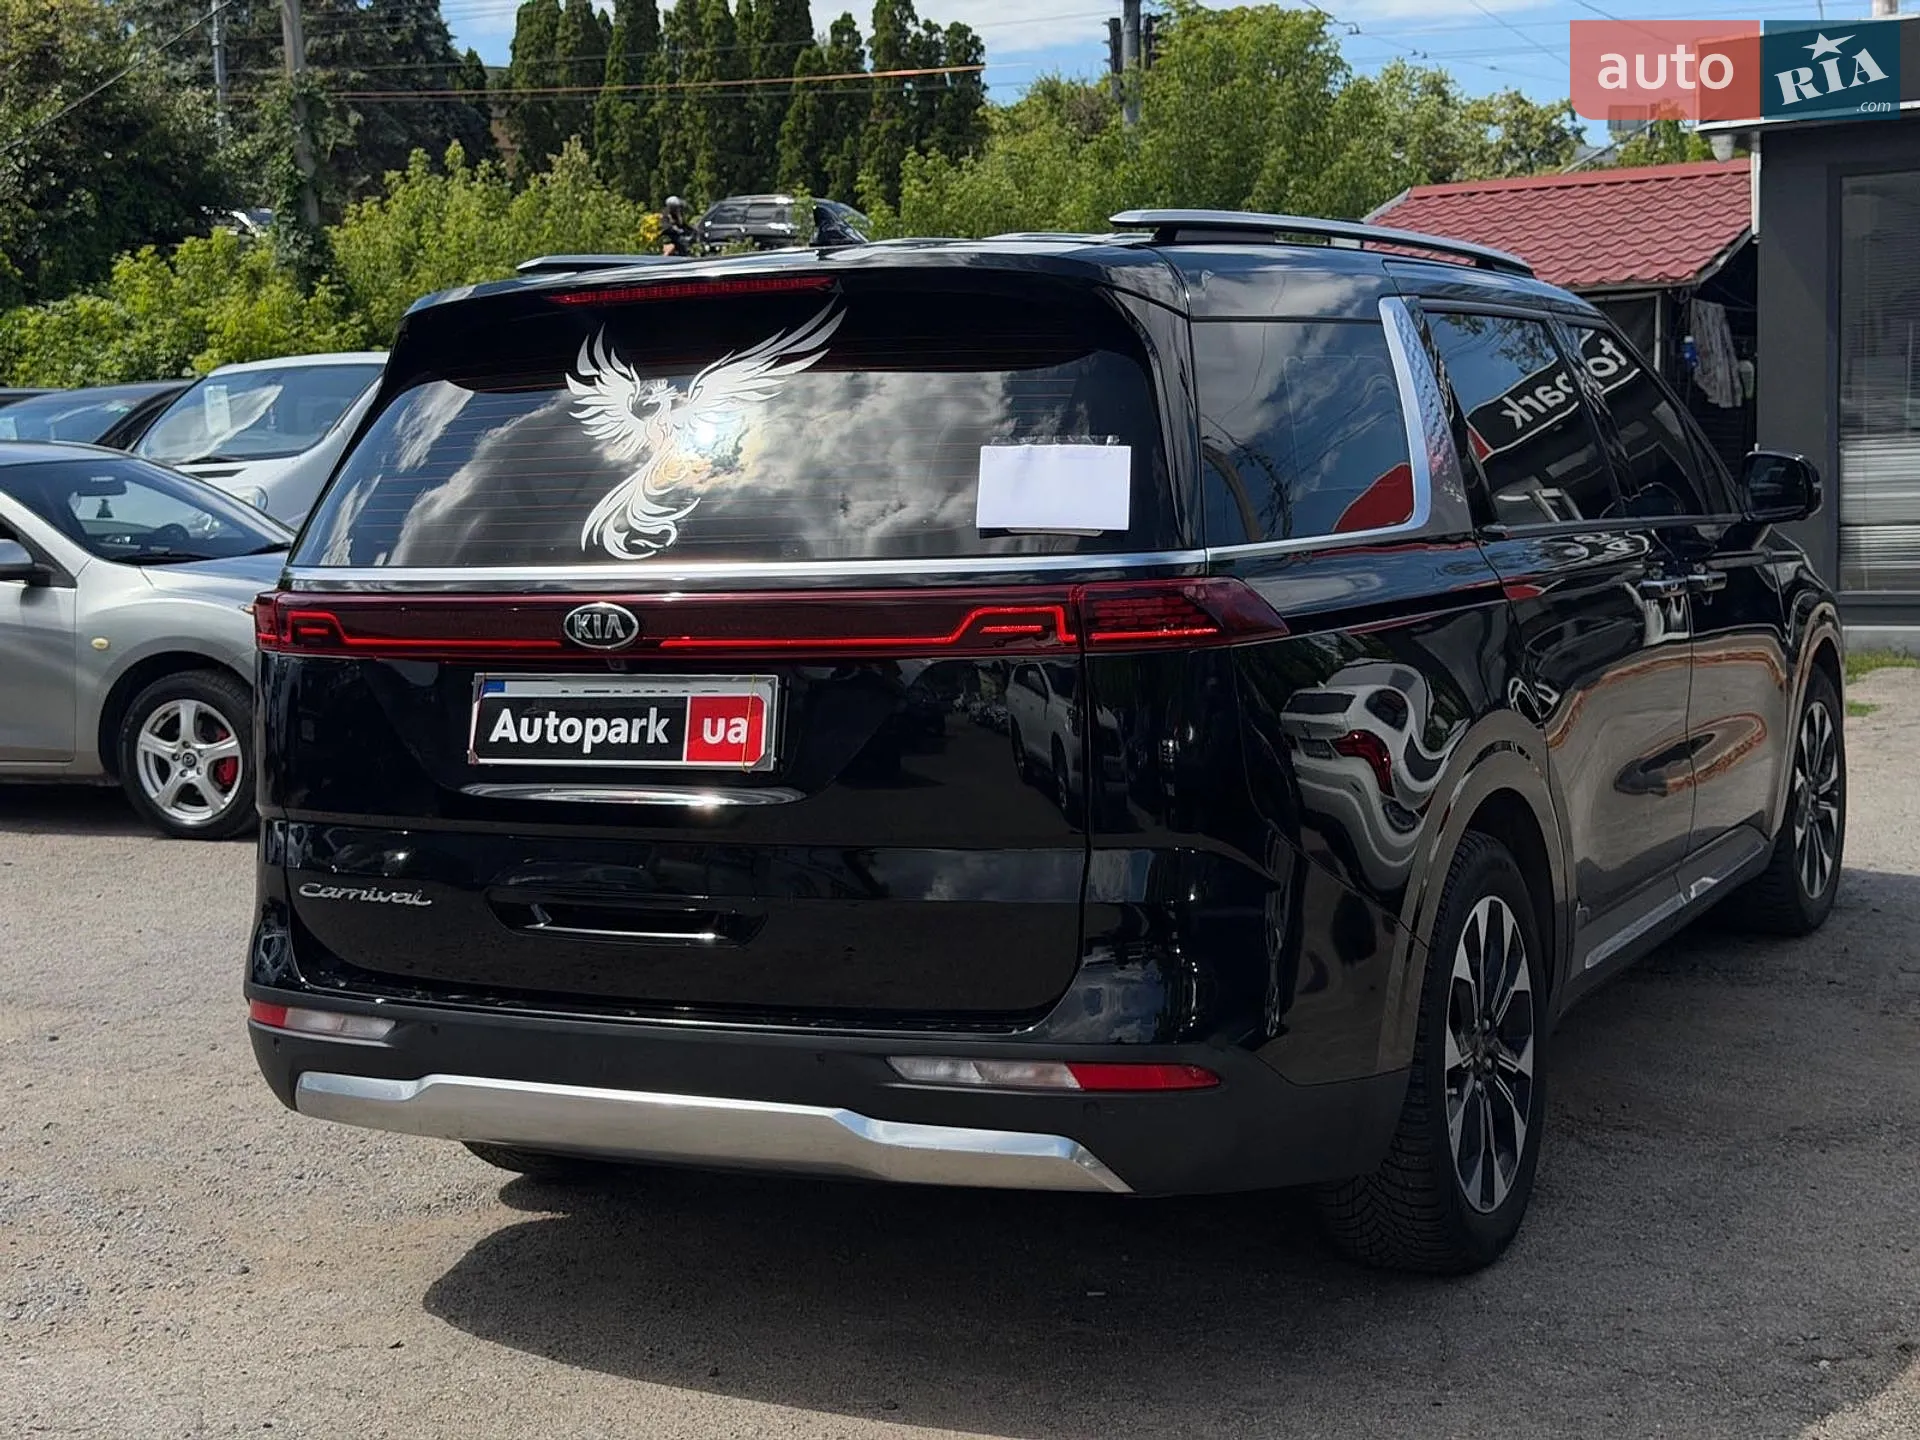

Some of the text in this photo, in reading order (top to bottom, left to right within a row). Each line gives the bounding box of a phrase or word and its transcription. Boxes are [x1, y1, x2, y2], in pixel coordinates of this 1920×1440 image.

[573, 613, 626, 639] KIA
[489, 707, 749, 754] Autopark ua
[299, 883, 432, 906] Carnival
